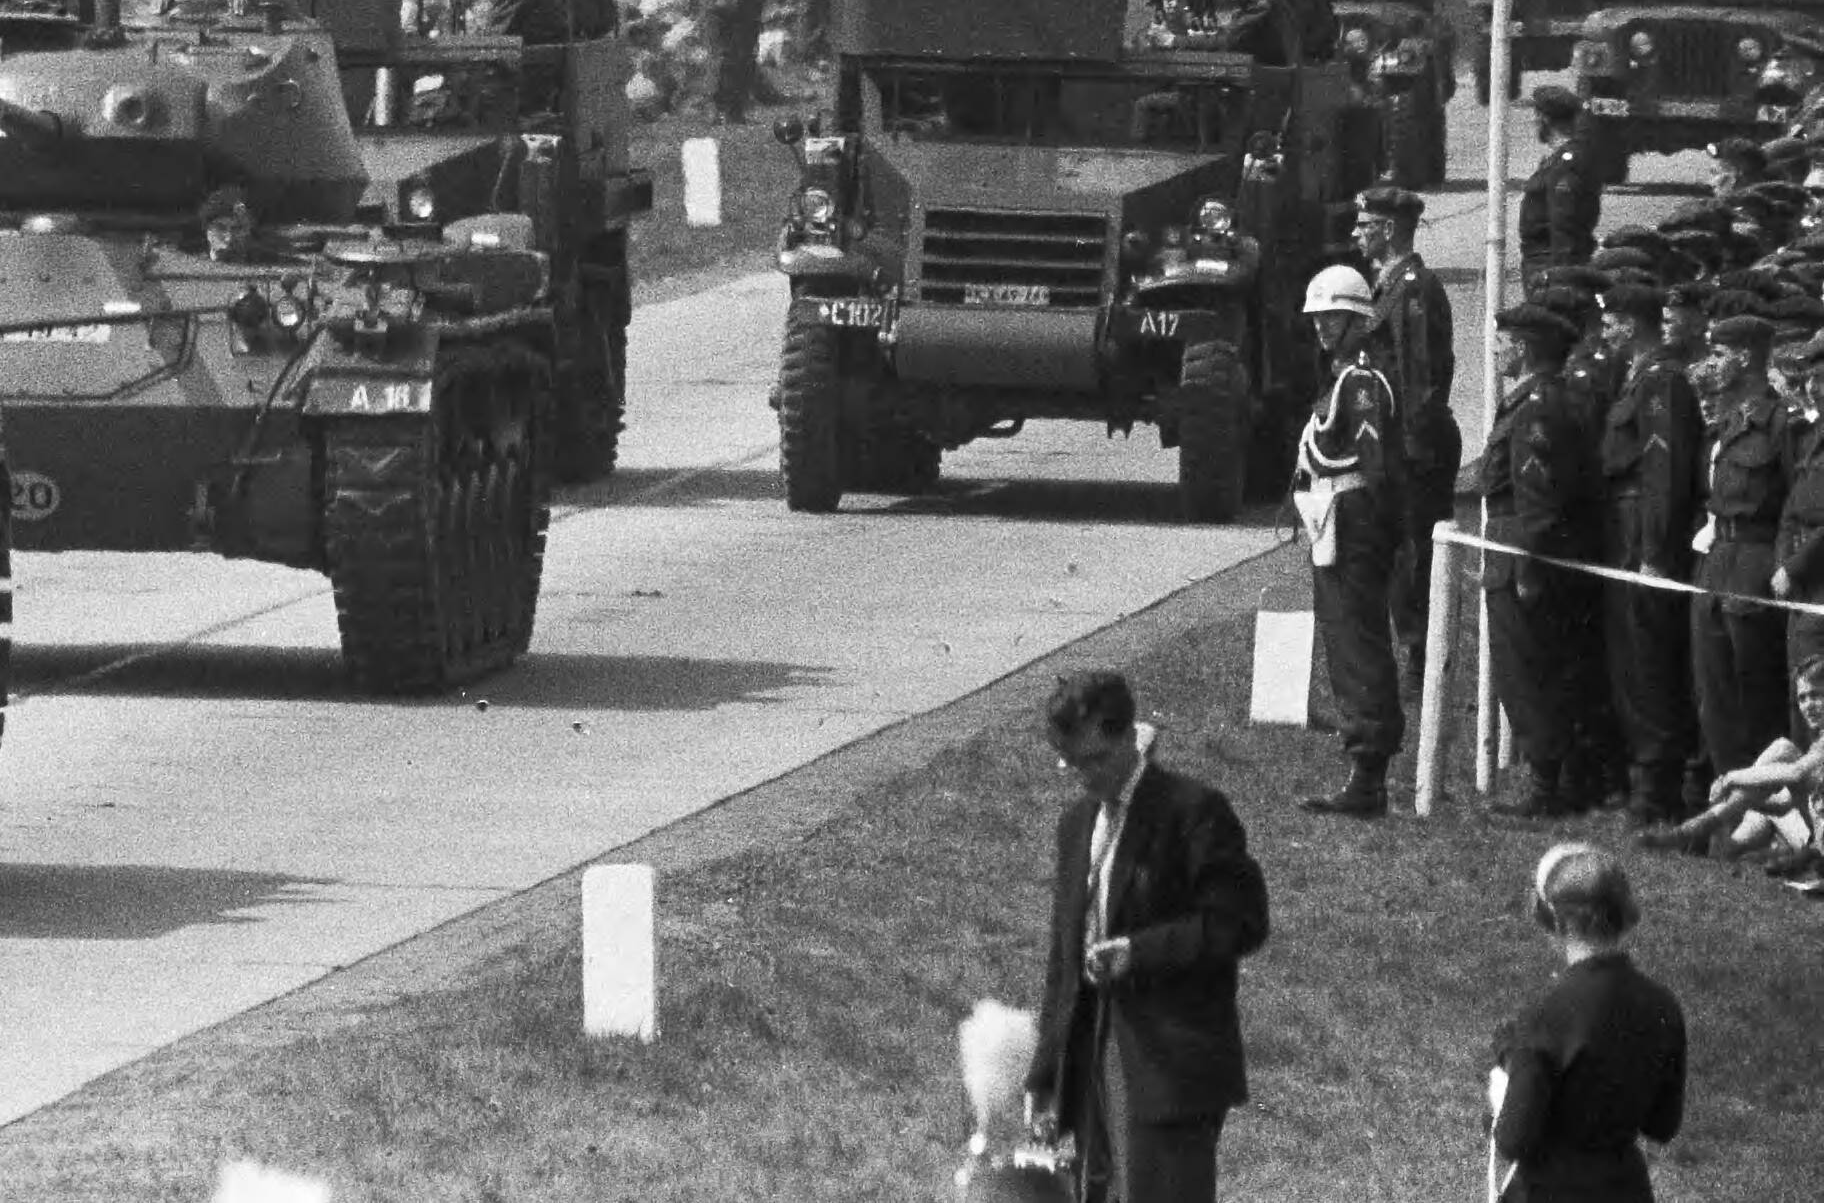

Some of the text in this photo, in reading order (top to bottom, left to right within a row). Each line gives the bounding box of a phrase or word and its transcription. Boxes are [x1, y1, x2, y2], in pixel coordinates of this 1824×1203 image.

[831, 301, 882, 326] C102
[1140, 309, 1180, 336] A17
[351, 384, 370, 410] A
